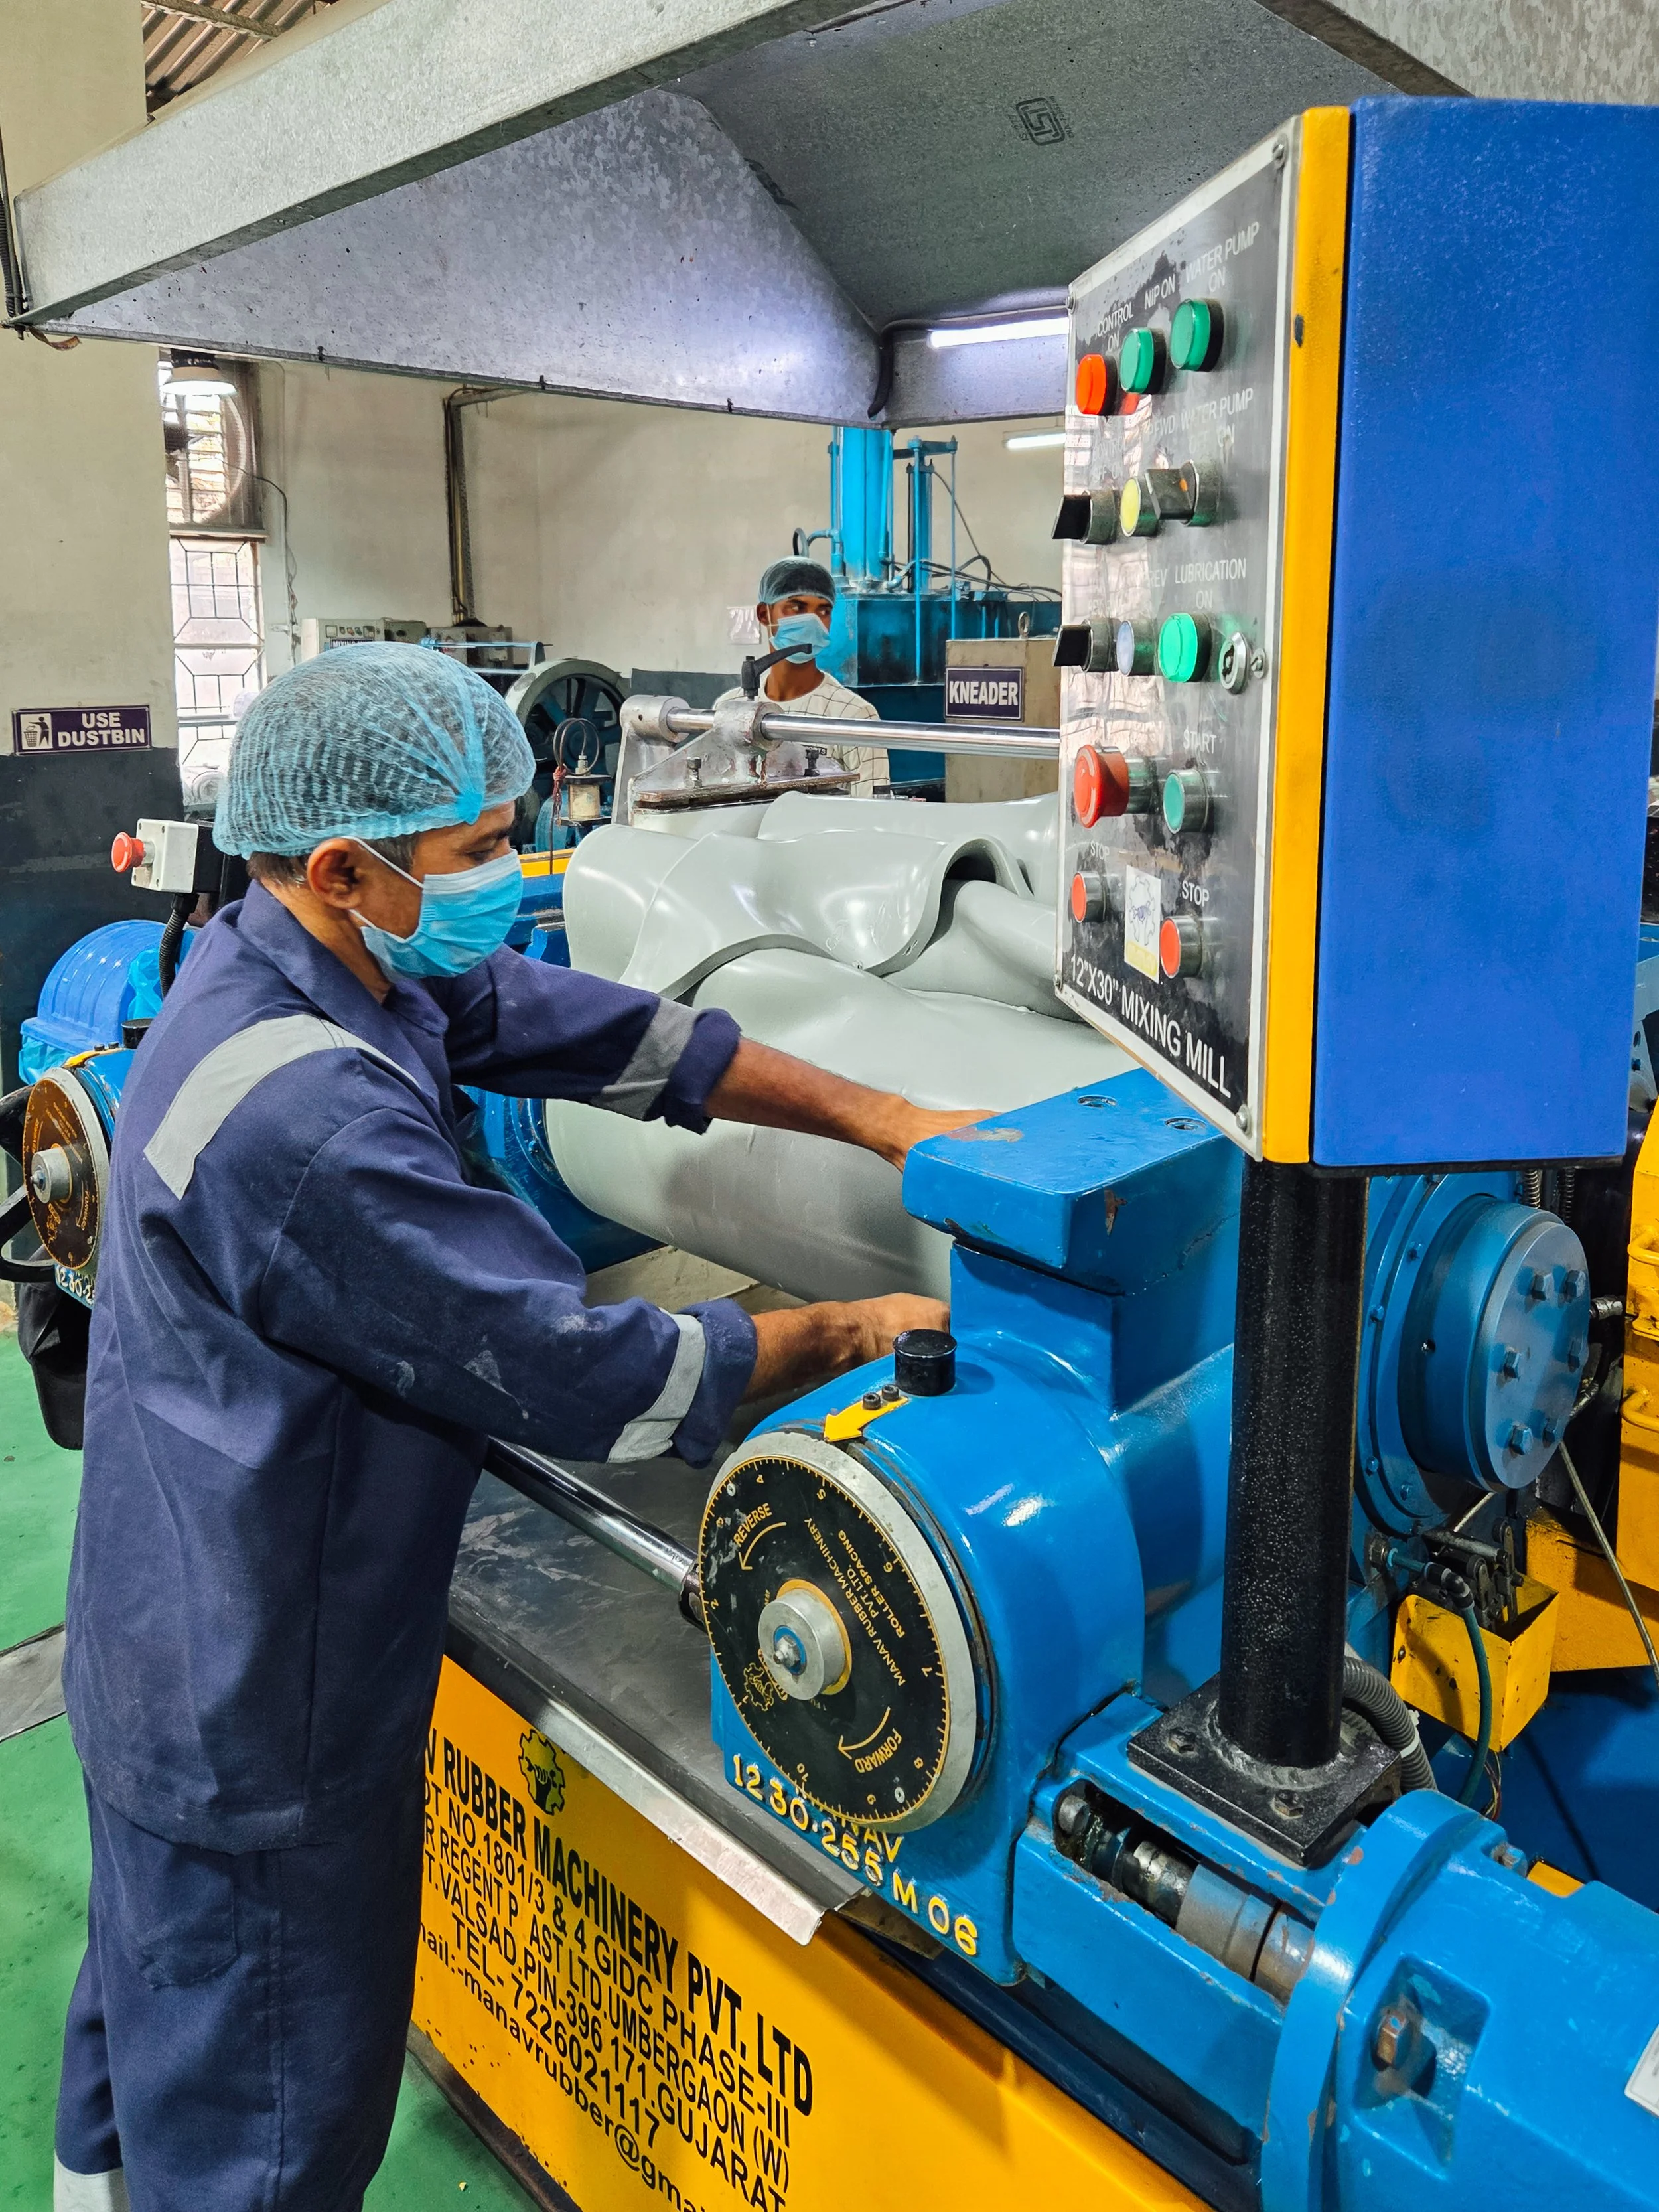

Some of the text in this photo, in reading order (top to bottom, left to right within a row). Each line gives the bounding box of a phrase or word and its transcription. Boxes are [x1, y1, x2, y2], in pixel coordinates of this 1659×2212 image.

[1184, 221, 1260, 284] WATER PUMP
[1144, 274, 1176, 310] NIP ON
[1208, 267, 1226, 293] ON
[1097, 301, 1134, 337] CONTROL
[1107, 331, 1120, 353] ON
[1220, 388, 1254, 417] PUMP
[1175, 558, 1247, 585] LUBRICATION
[1196, 590, 1213, 609] ON
[949, 680, 1019, 706] KNEADER
[82, 711, 121, 729] USE
[58, 727, 145, 747] DUSTBIN
[1183, 728, 1218, 755] START
[1090, 840, 1110, 861] STOP
[1181, 881, 1210, 907] STOP
[1121, 984, 1182, 1058] MIXING
[1185, 1031, 1232, 1099] MILL
[817, 1489, 826, 1501] 5
[733, 1502, 773, 1548] REVERSE
[837, 1529, 906, 1638] ROLLER SPACING
[710, 1598, 719, 1610] 2
[804, 1517, 906, 1687] MANAV RUBBER MACHINERY
[854, 1728, 902, 1773] FORWARD
[444, 1736, 528, 1861] RUBBER
[534, 1816, 679, 1994] MACHINERY
[687, 1951, 747, 2061] PVT.
[757, 2012, 813, 2117] LTD
[439, 1826, 503, 1916] REGENT
[753, 2125, 789, 2194] (W)
[552, 1895, 567, 1938] &
[574, 1917, 587, 1954] 4
[593, 1935, 654, 2016] GIDC
[662, 1993, 790, 2148] PHASE-III
[511, 1972, 660, 2149] 7226021117
